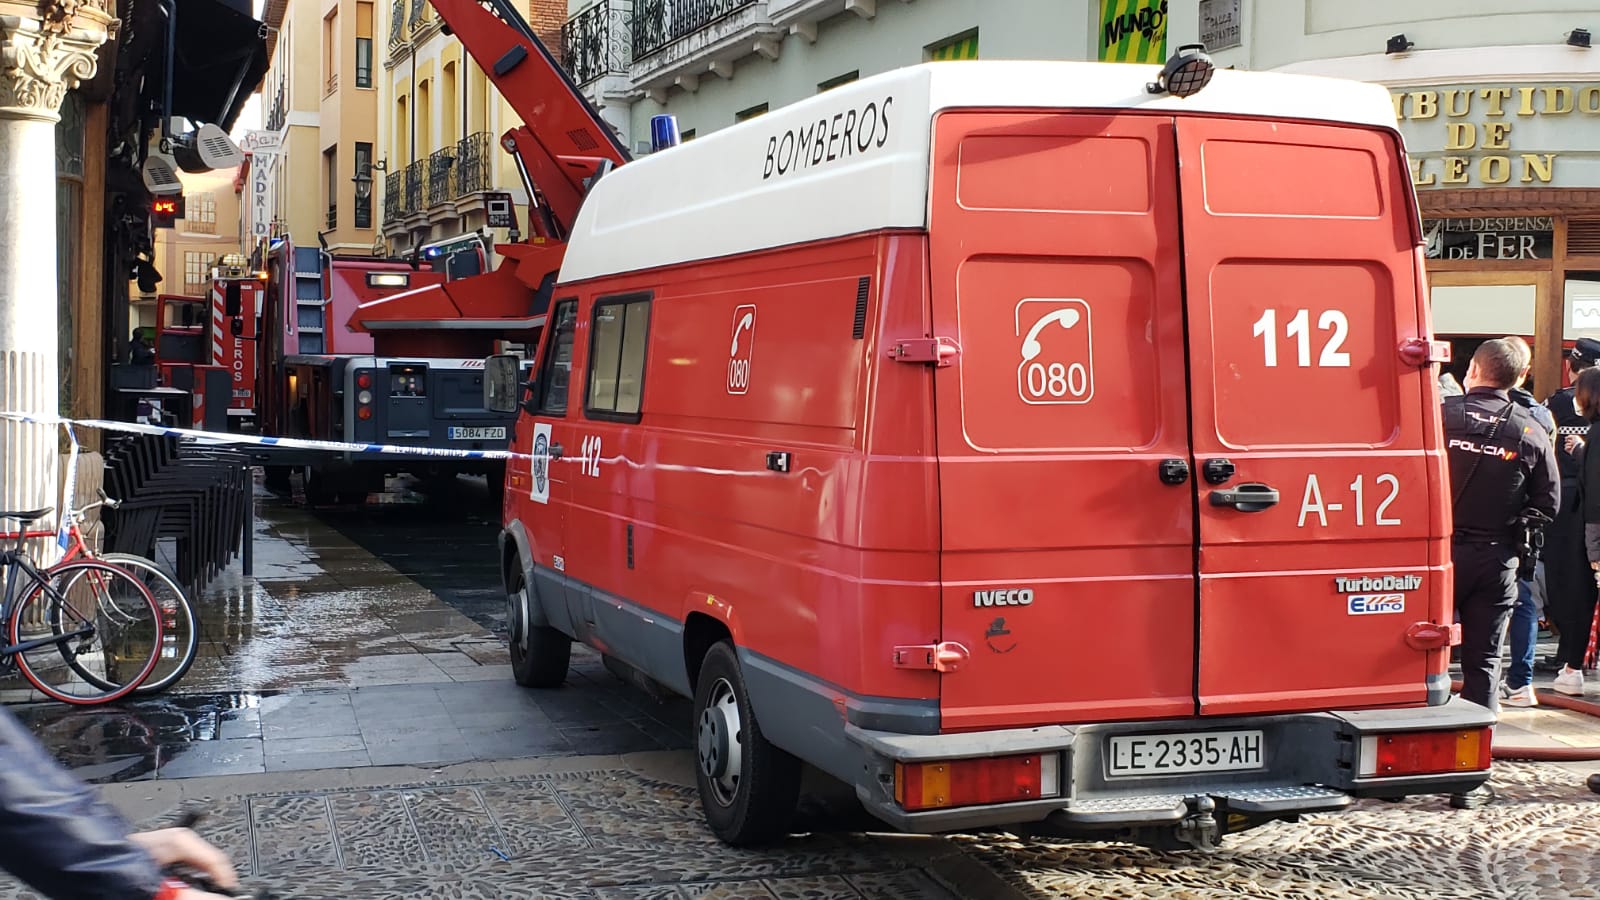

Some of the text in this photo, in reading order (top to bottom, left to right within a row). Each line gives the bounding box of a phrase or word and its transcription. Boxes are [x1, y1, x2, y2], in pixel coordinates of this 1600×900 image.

[1104, 7, 1163, 48] MUNDO
[245, 133, 280, 148] Bar
[763, 96, 893, 180] BOMBEROS
[1444, 122, 1512, 150] DE
[1410, 154, 1557, 185] LEON
[255, 155, 267, 235] MADRID
[1446, 217, 1554, 232] LA DESPENSA
[1449, 233, 1539, 260] DE FER
[1253, 309, 1350, 367] 112
[730, 359, 748, 388] 080
[1027, 362, 1087, 397] 080
[455, 427, 481, 438] 5084
[581, 434, 601, 477] 112
[1297, 473, 1401, 527] A-12
[974, 589, 1034, 607] IVECO
[1335, 575, 1422, 593] TurboDaily
[1350, 597, 1403, 613] Euro
